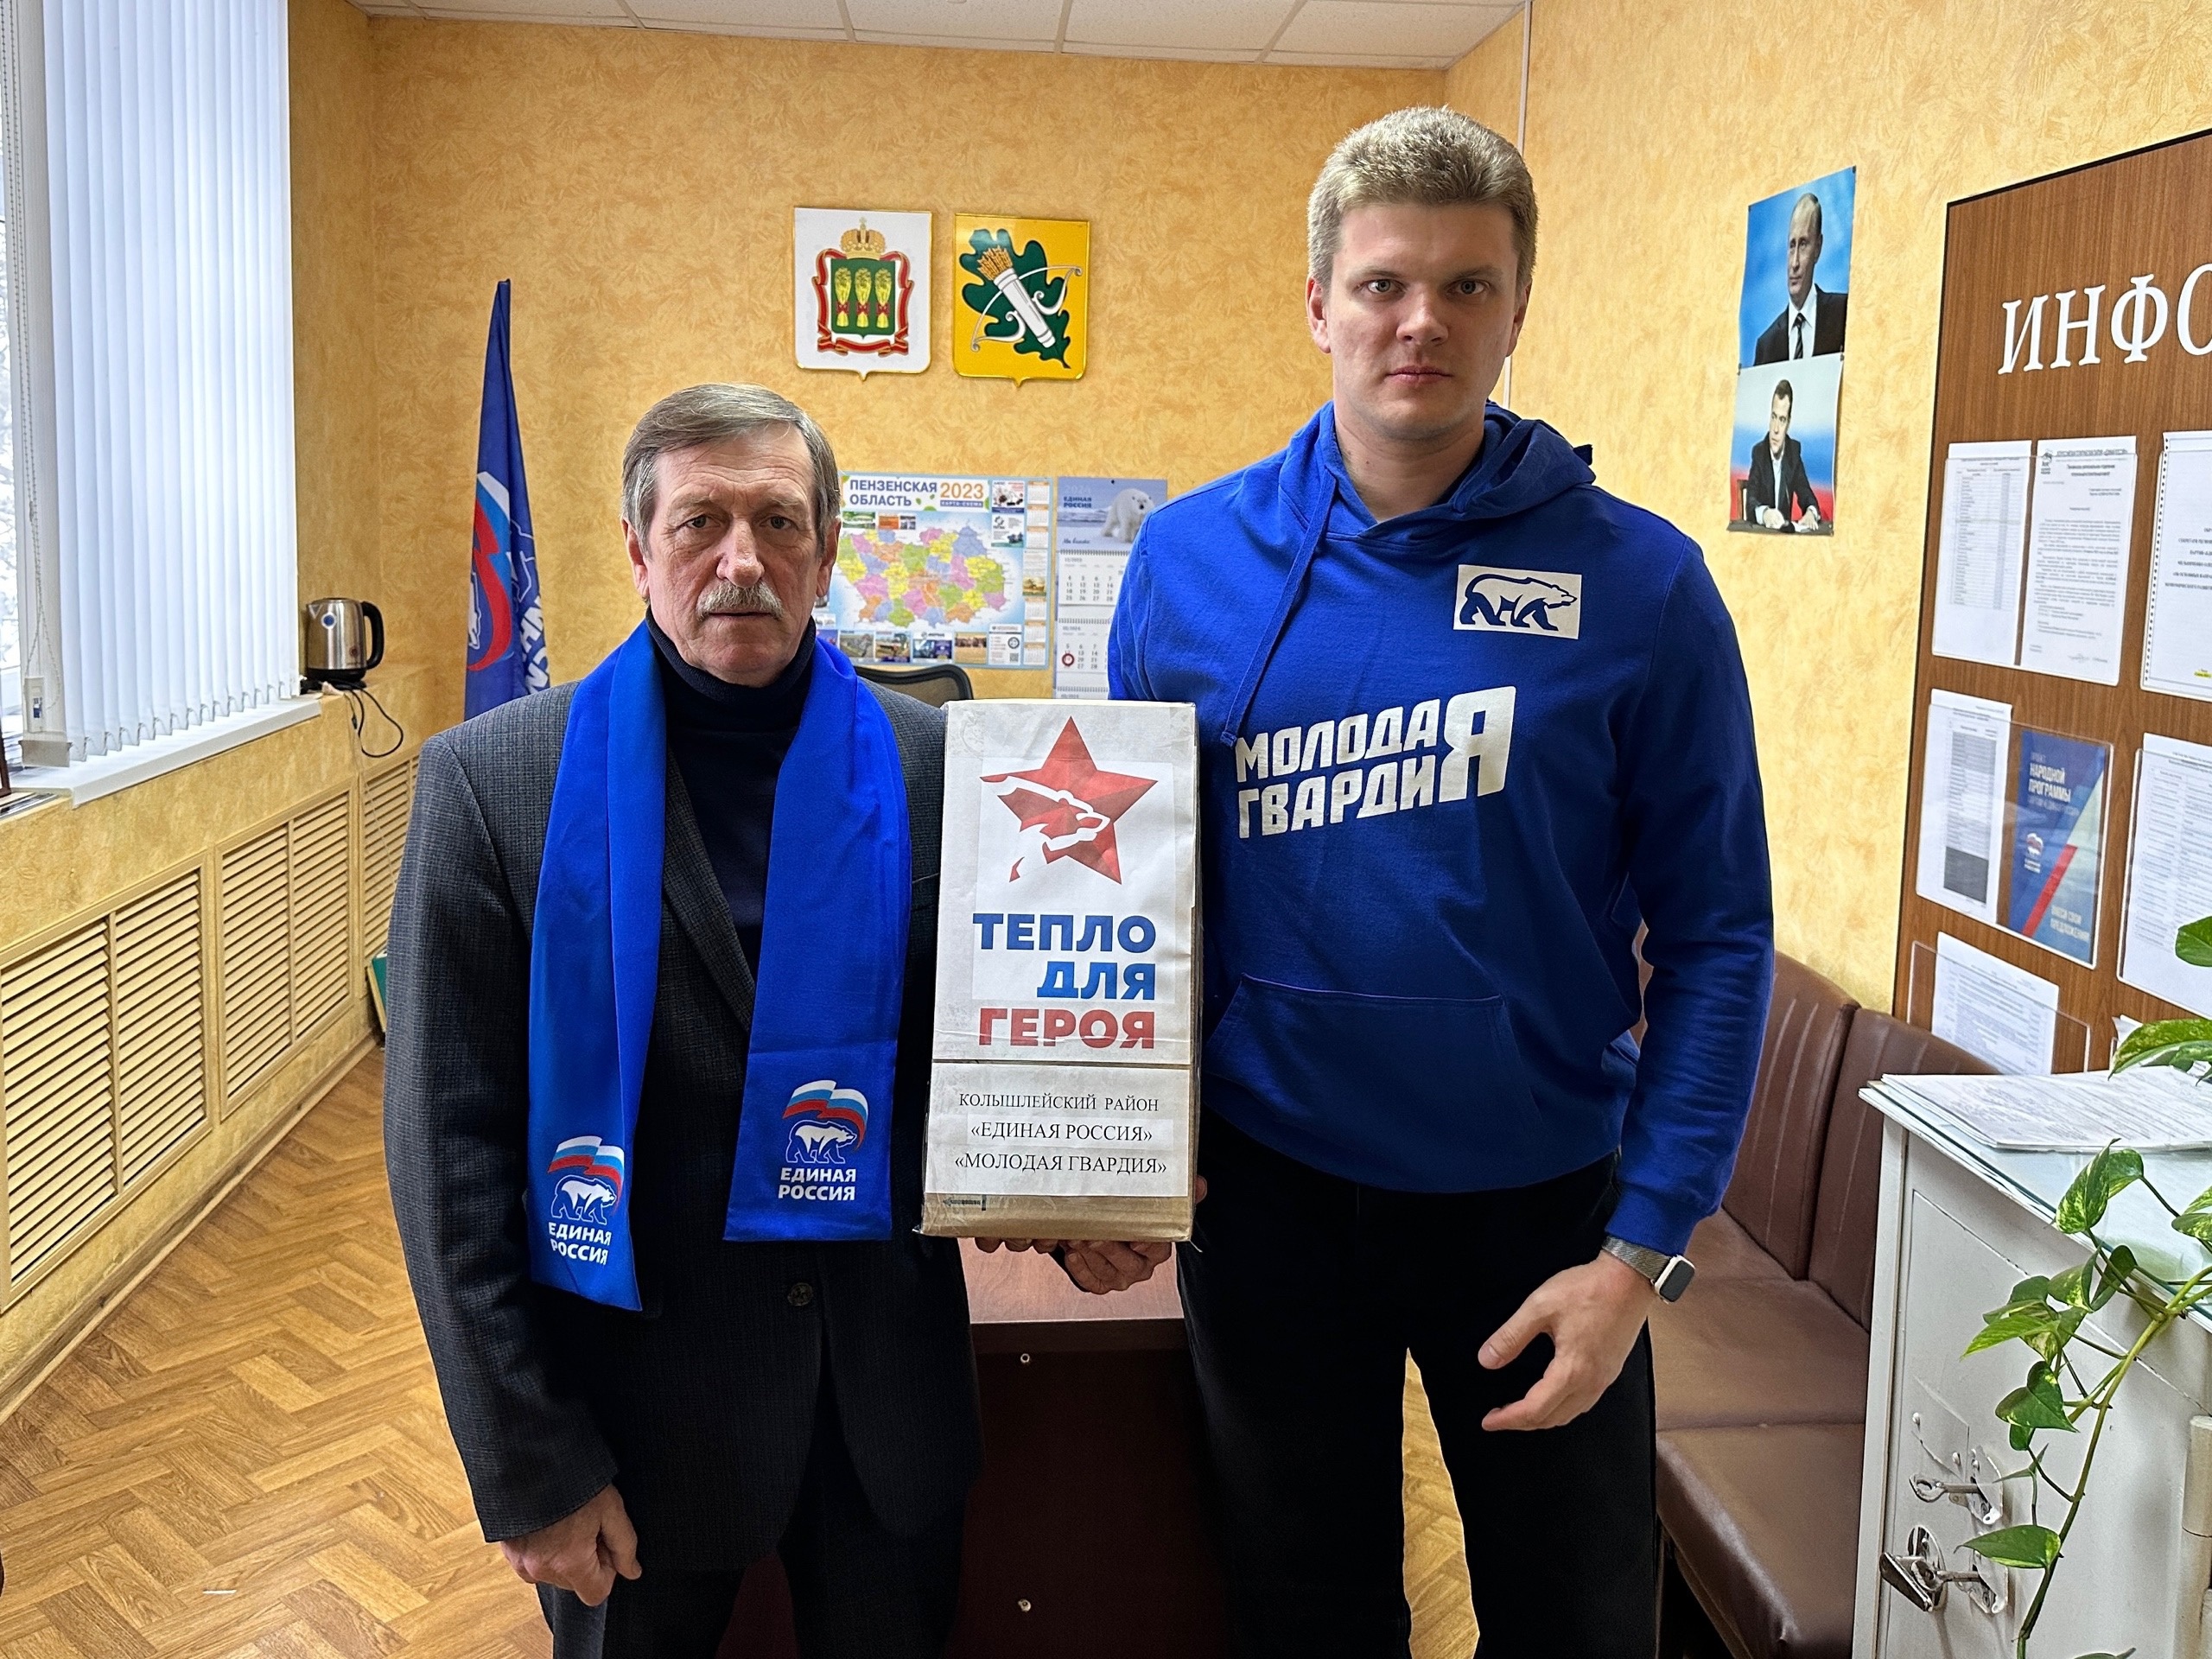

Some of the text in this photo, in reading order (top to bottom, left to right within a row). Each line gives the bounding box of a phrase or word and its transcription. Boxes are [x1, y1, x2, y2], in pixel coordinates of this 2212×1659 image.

[849, 480, 938, 493] ПЕНЗЕНСКАЯ
[940, 482, 984, 499] 2023
[849, 493, 912, 506] ОБЛАСТЬ
[2030, 762, 2066, 785] НАРОДНОЙ
[2028, 779, 2072, 804] ПРОГРАММЫ
[972, 913, 1156, 953] ТЕПЛО
[1037, 961, 1156, 1001] ДЛЯ
[978, 1007, 1155, 1050] ГЕРОЯ
[958, 1092, 1159, 1112] КОЛЫШЛЕЙСКИЙ РАЙОН
[971, 1122, 1152, 1141] «ЕДИНАЯ РОССИЯ»
[955, 1153, 1166, 1174] «МОЛОДАЯ ГВАРДИЯ»
[780, 1166, 856, 1183] ЕДИНАЯ
[778, 1185, 855, 1202] РОССИЯ
[548, 1221, 612, 1246] ЕДИНАЯ
[550, 1238, 608, 1266] РОССИЯ
